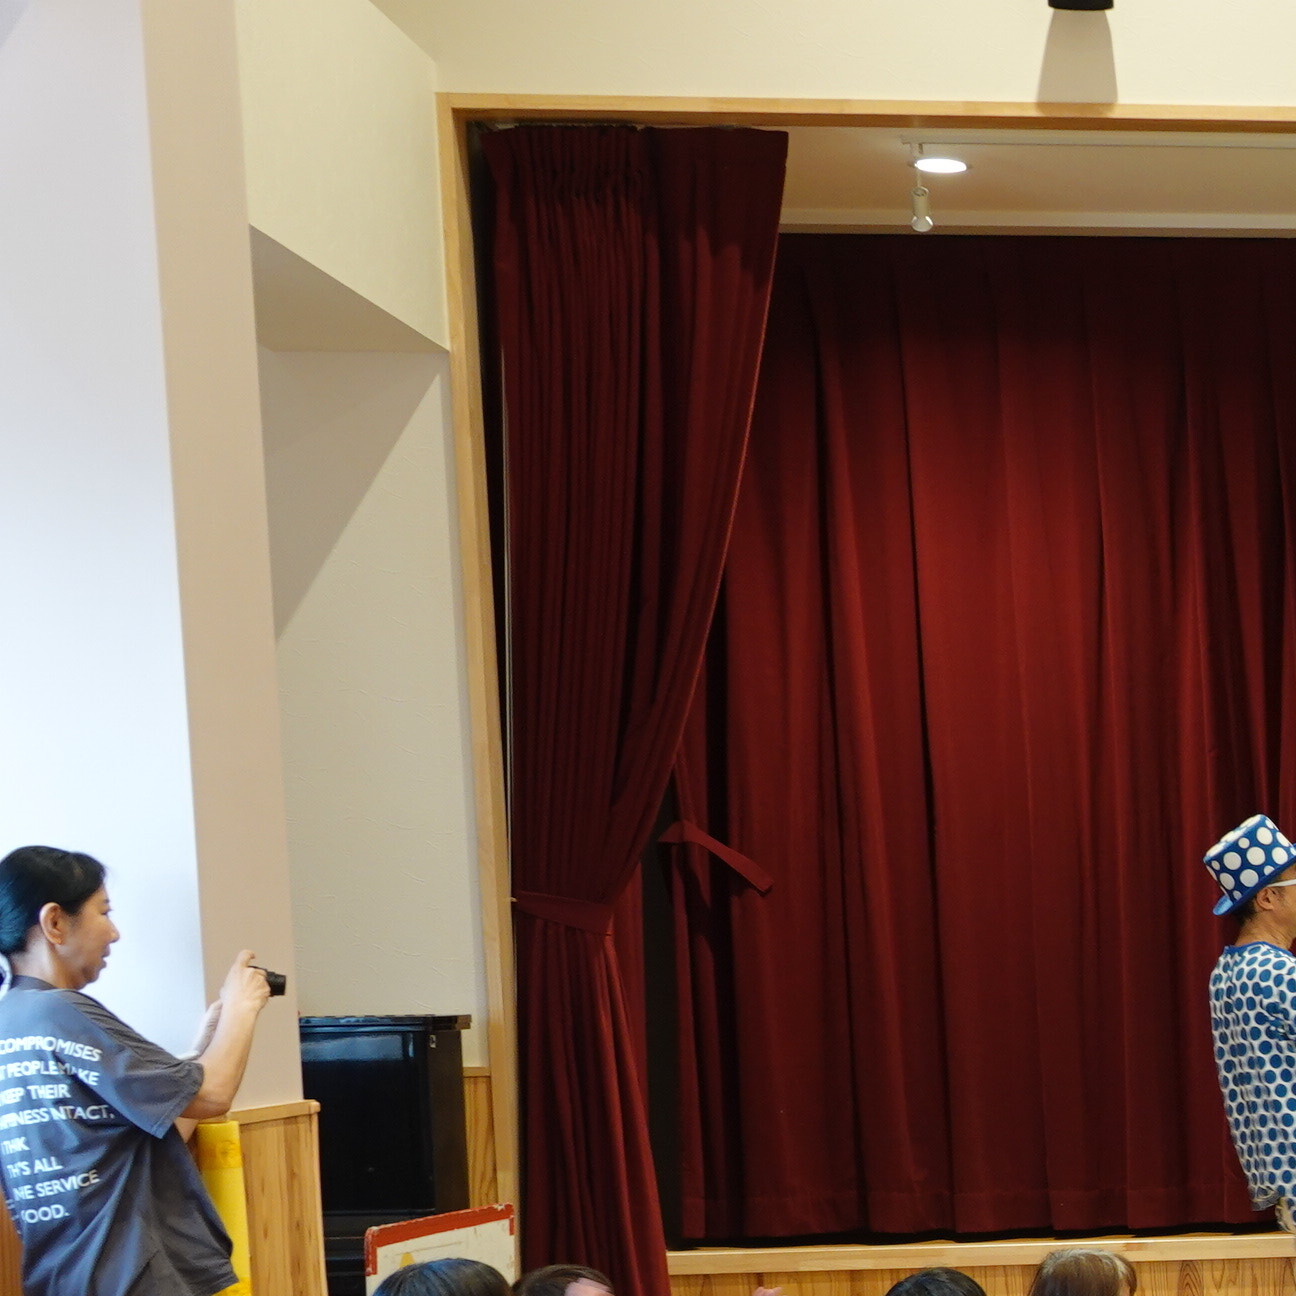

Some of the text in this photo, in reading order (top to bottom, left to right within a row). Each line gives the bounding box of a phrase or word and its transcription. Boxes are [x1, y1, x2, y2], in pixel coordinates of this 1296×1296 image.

[0, 1036, 103, 1062] COMPROMISES
[6, 1060, 58, 1079] PEOPLE
[27, 1084, 72, 1100] THEIR
[49, 1105, 115, 1121] NTACT.
[33, 1156, 63, 1174] ALL
[35, 1169, 100, 1198] SERVICE
